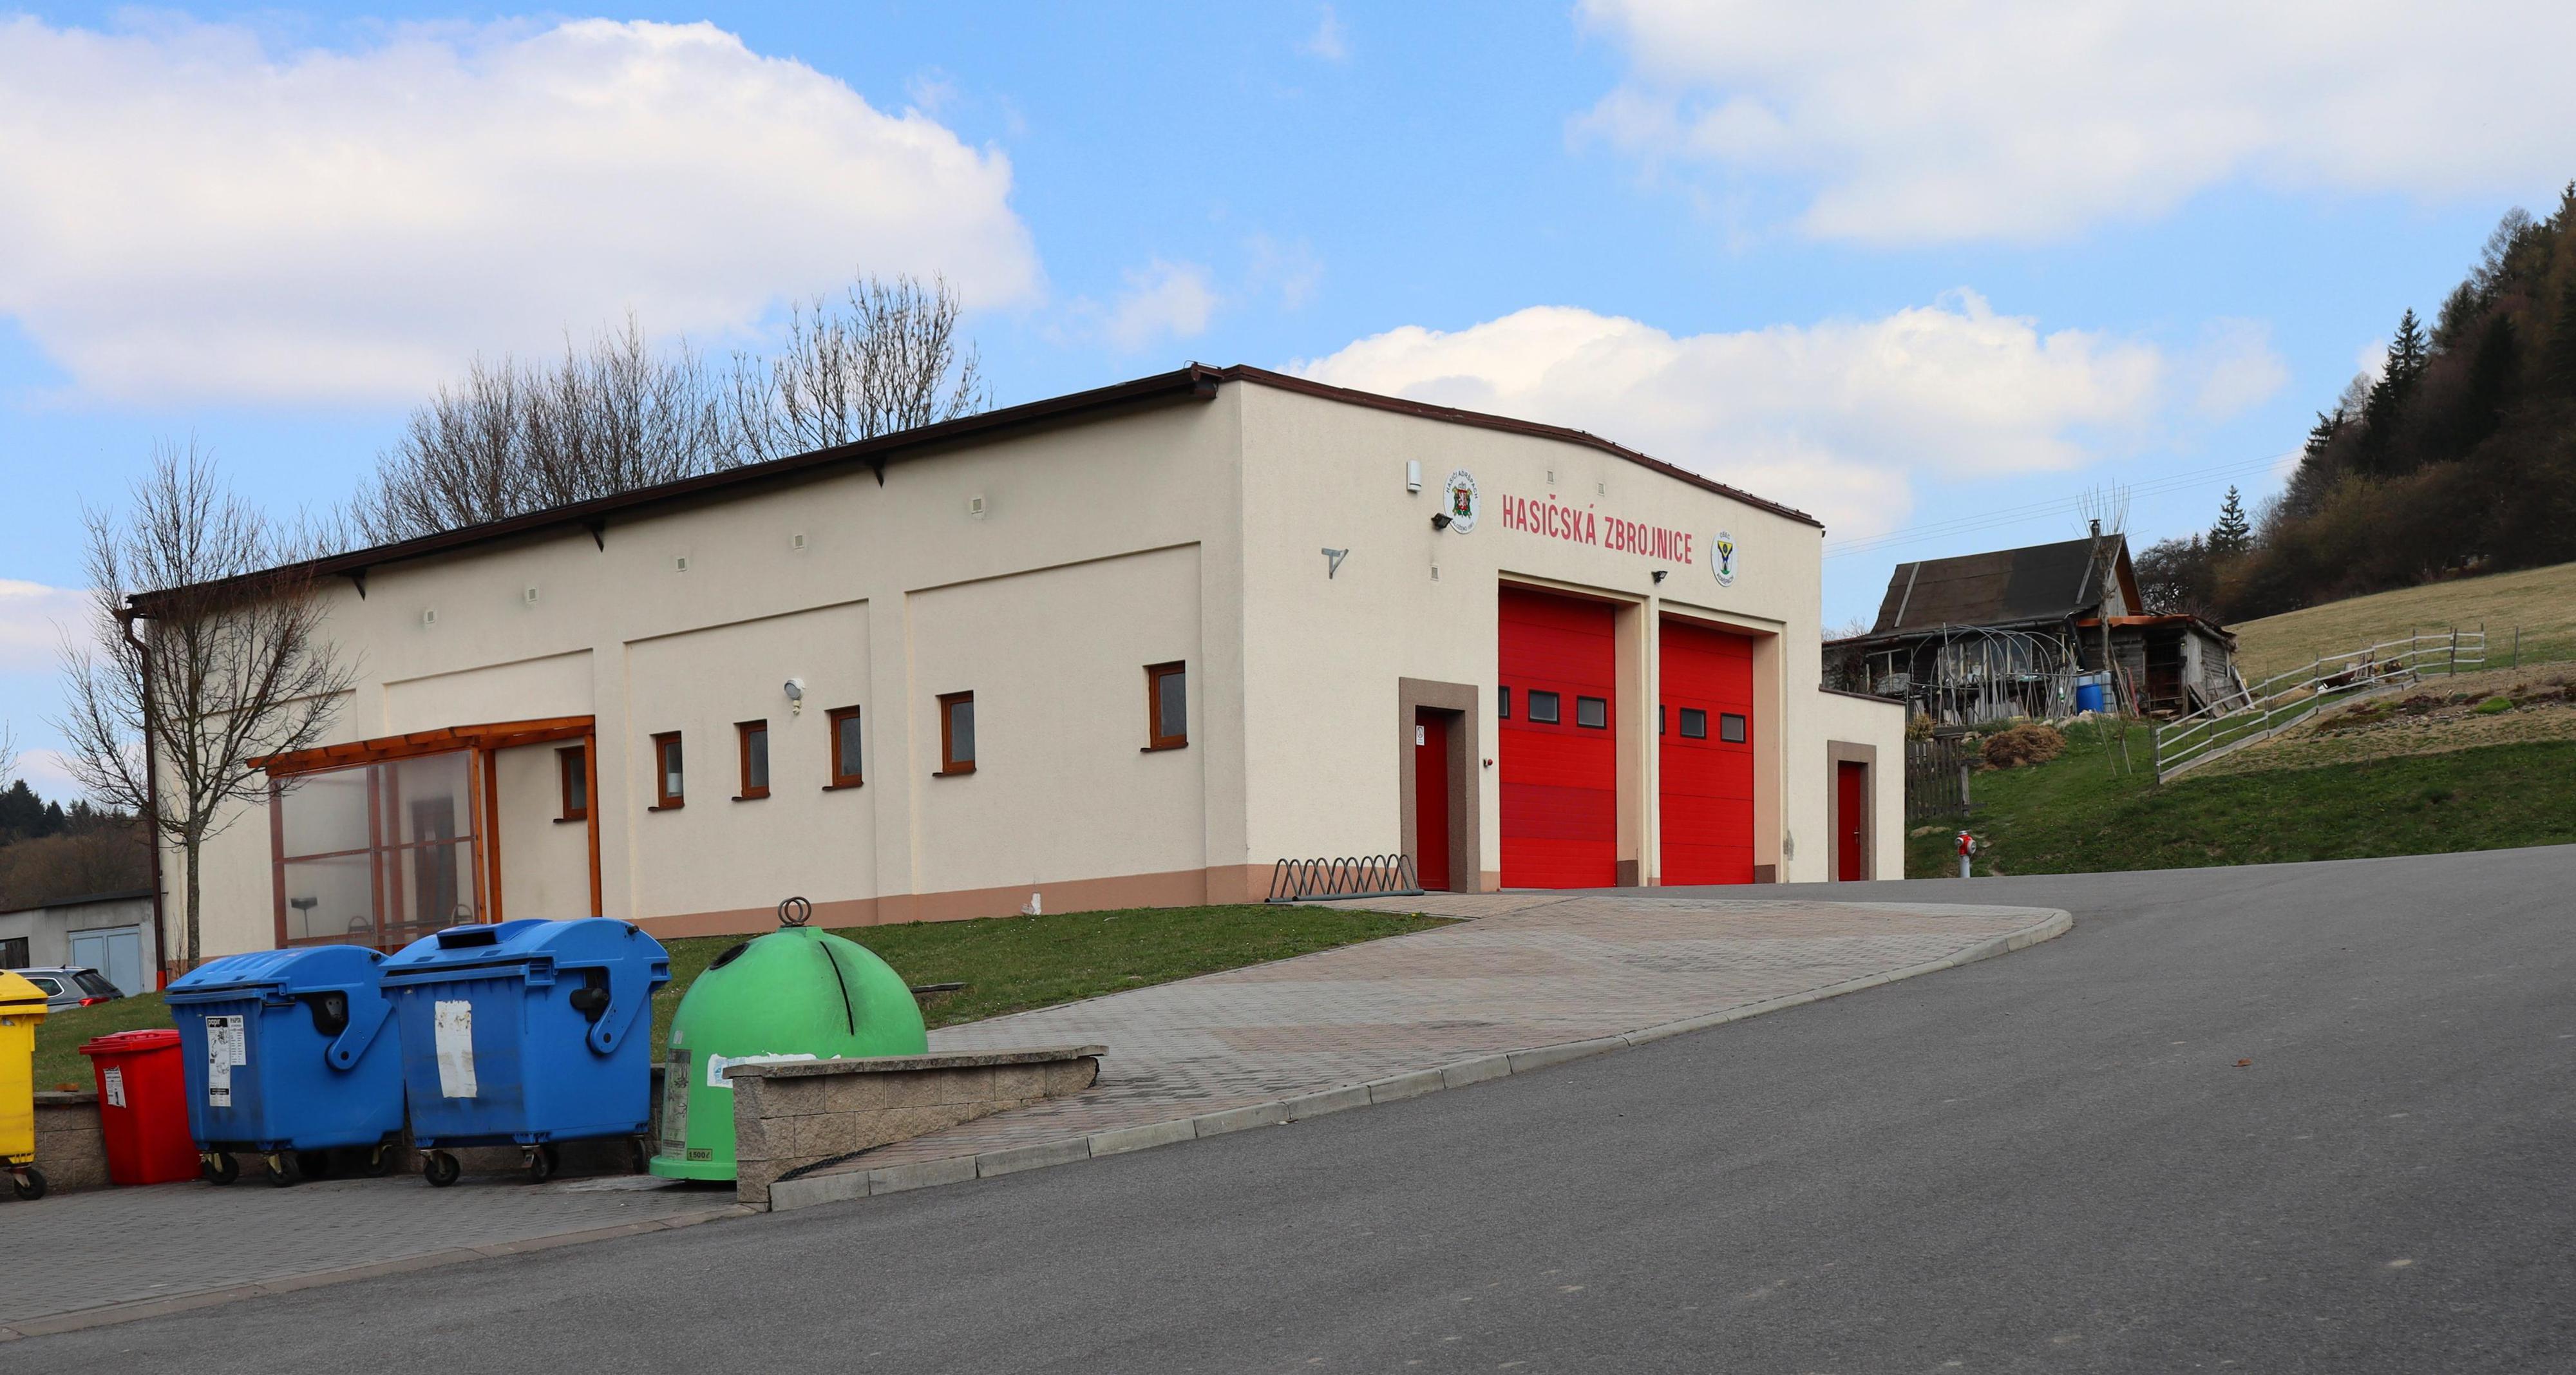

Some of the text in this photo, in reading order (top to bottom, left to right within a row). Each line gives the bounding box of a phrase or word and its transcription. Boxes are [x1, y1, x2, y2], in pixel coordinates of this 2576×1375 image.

[1446, 470, 1478, 499] HASIČI ADRŠPACH
[1502, 493, 1692, 564] HASIČSKÁ ZBROJNICE
